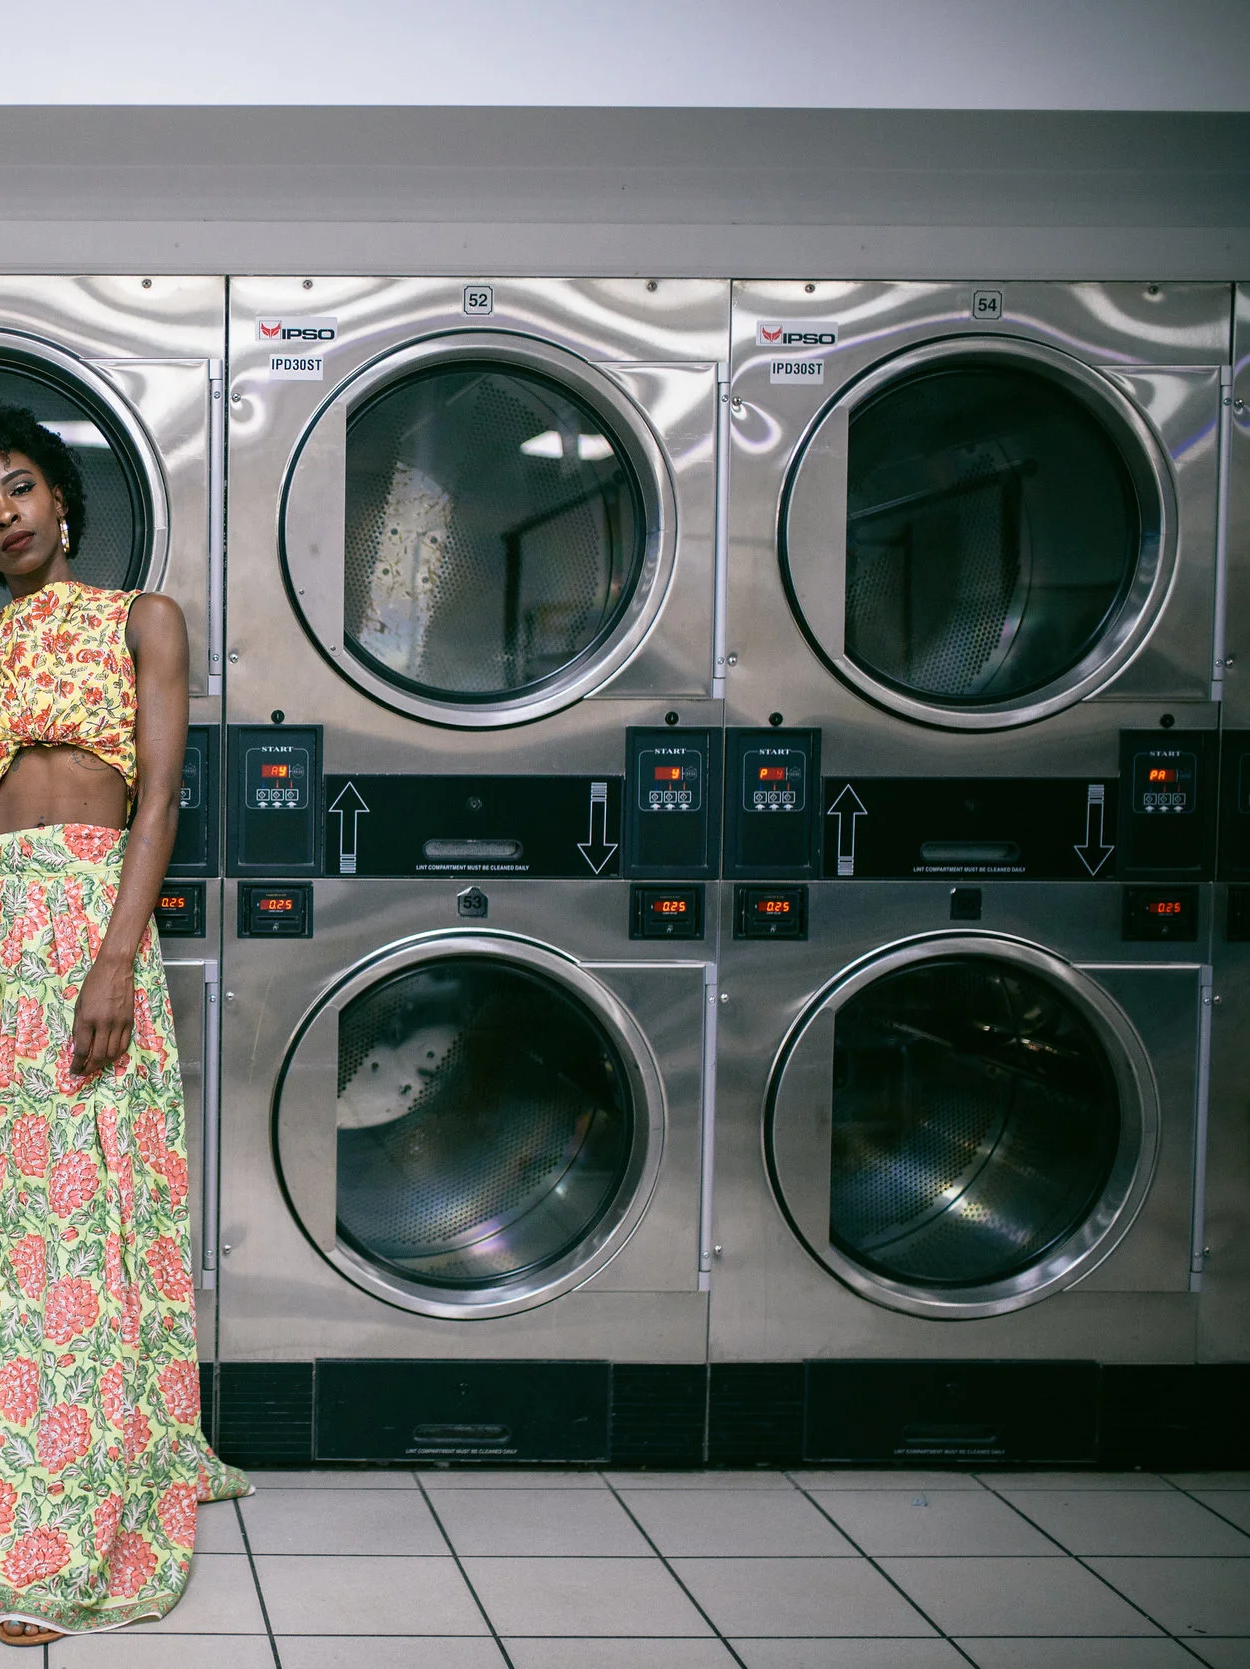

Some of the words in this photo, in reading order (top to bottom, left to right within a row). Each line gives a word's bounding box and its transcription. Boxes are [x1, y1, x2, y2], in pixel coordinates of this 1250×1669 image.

[469, 294, 488, 307] 52
[978, 298, 997, 312] 54
[282, 329, 335, 340] IPSO
[783, 333, 836, 344] IPSO
[272, 358, 322, 371] IPD30ST
[772, 363, 823, 375] IPD30ST
[463, 896, 482, 909] 53
